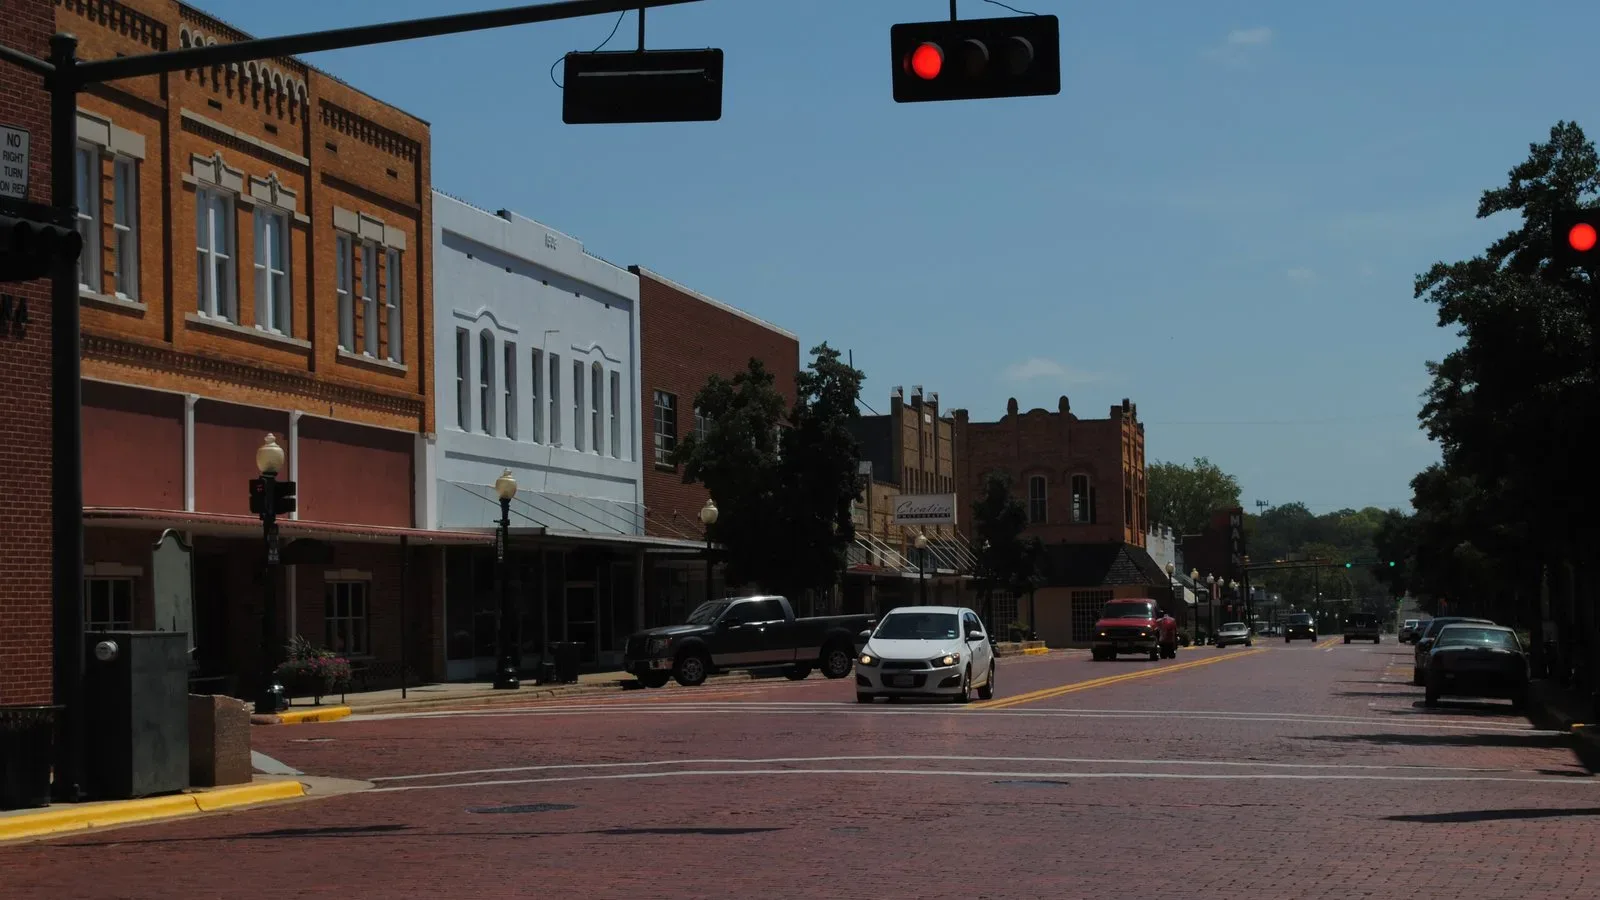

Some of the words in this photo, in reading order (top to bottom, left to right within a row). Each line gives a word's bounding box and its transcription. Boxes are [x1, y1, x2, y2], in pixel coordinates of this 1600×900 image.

[6, 132, 21, 148] NO
[2, 150, 24, 164] RIGHT
[4, 166, 23, 179] TURN
[0, 180, 10, 193] ON
[12, 182, 26, 195] RED
[896, 500, 951, 514] Creative
